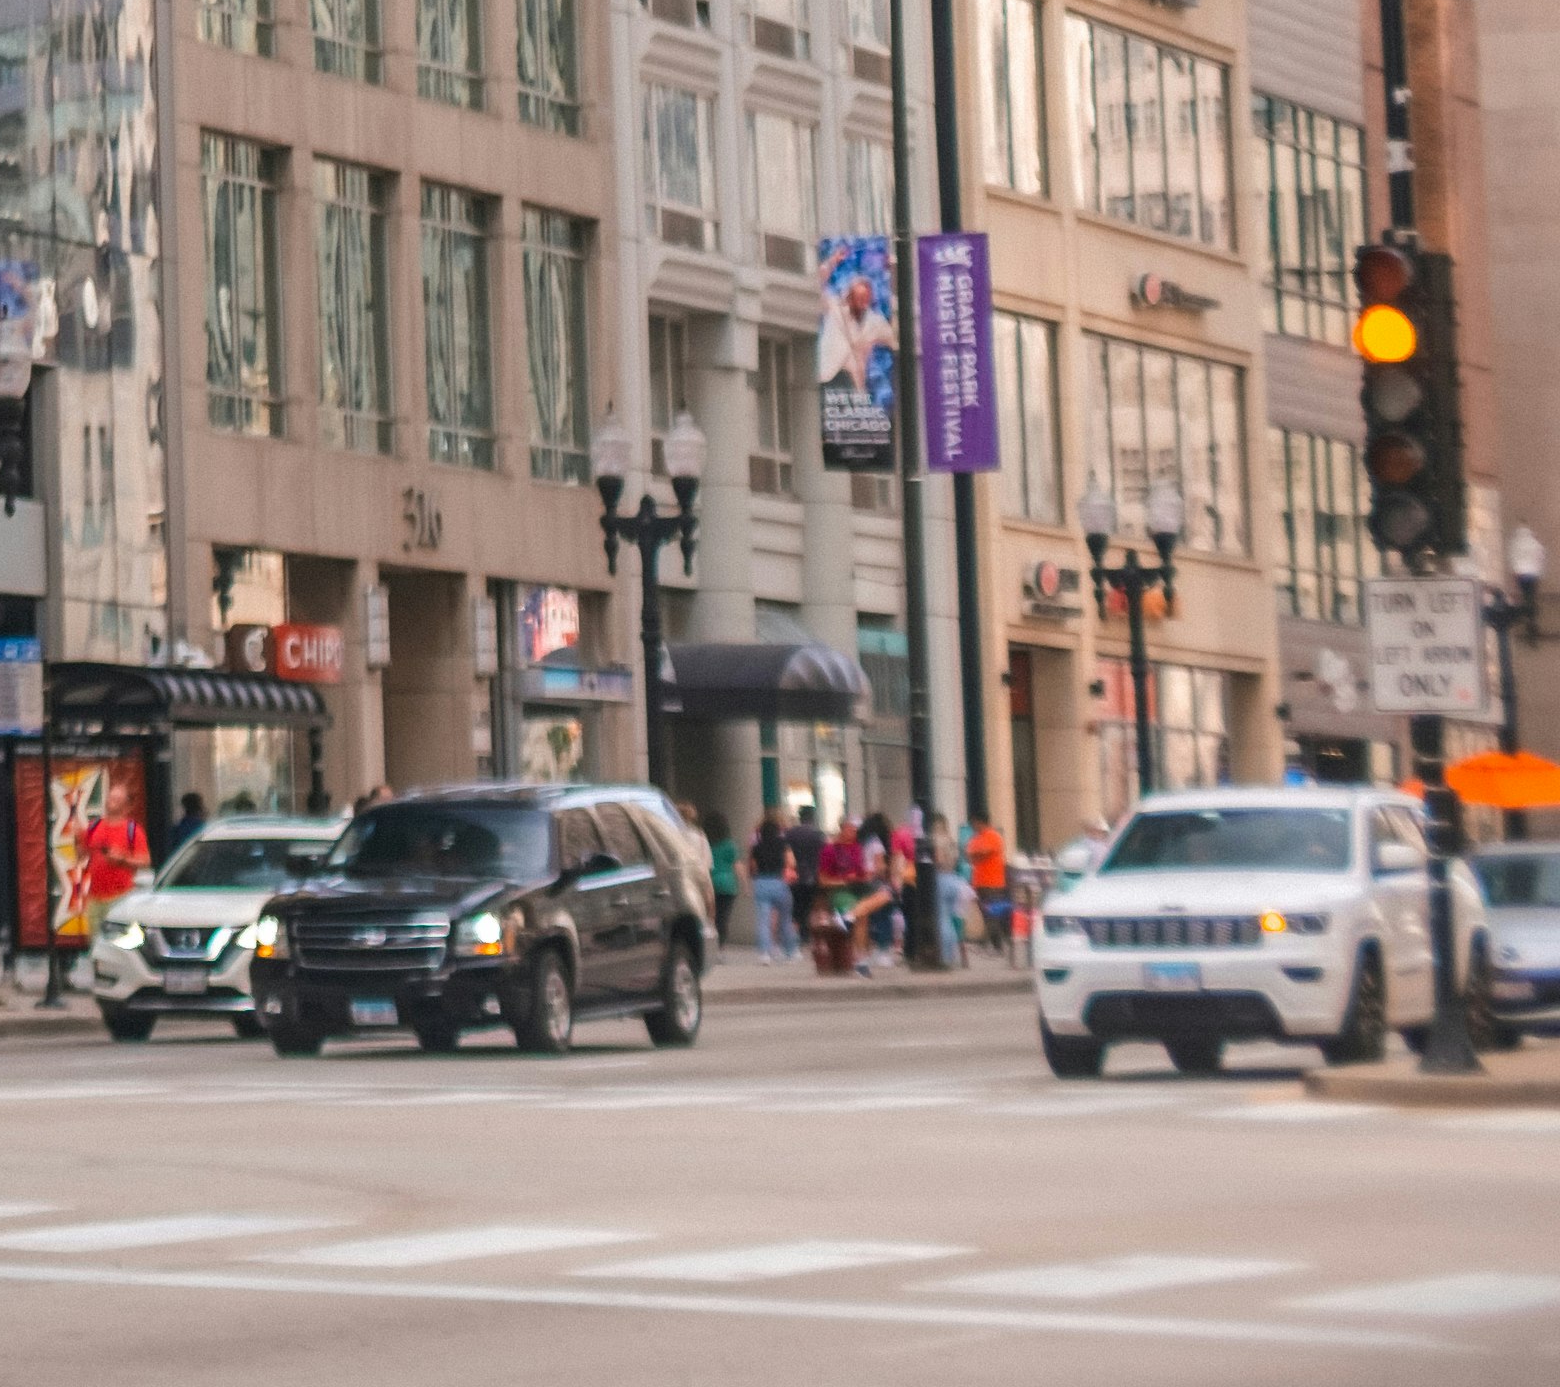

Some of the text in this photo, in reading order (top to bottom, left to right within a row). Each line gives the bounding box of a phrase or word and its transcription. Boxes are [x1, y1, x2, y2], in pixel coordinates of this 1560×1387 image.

[937, 274, 965, 459] MUSIC FESTIVAL
[955, 275, 980, 407] GRANT PARK
[1399, 673, 1449, 697] ONLY
